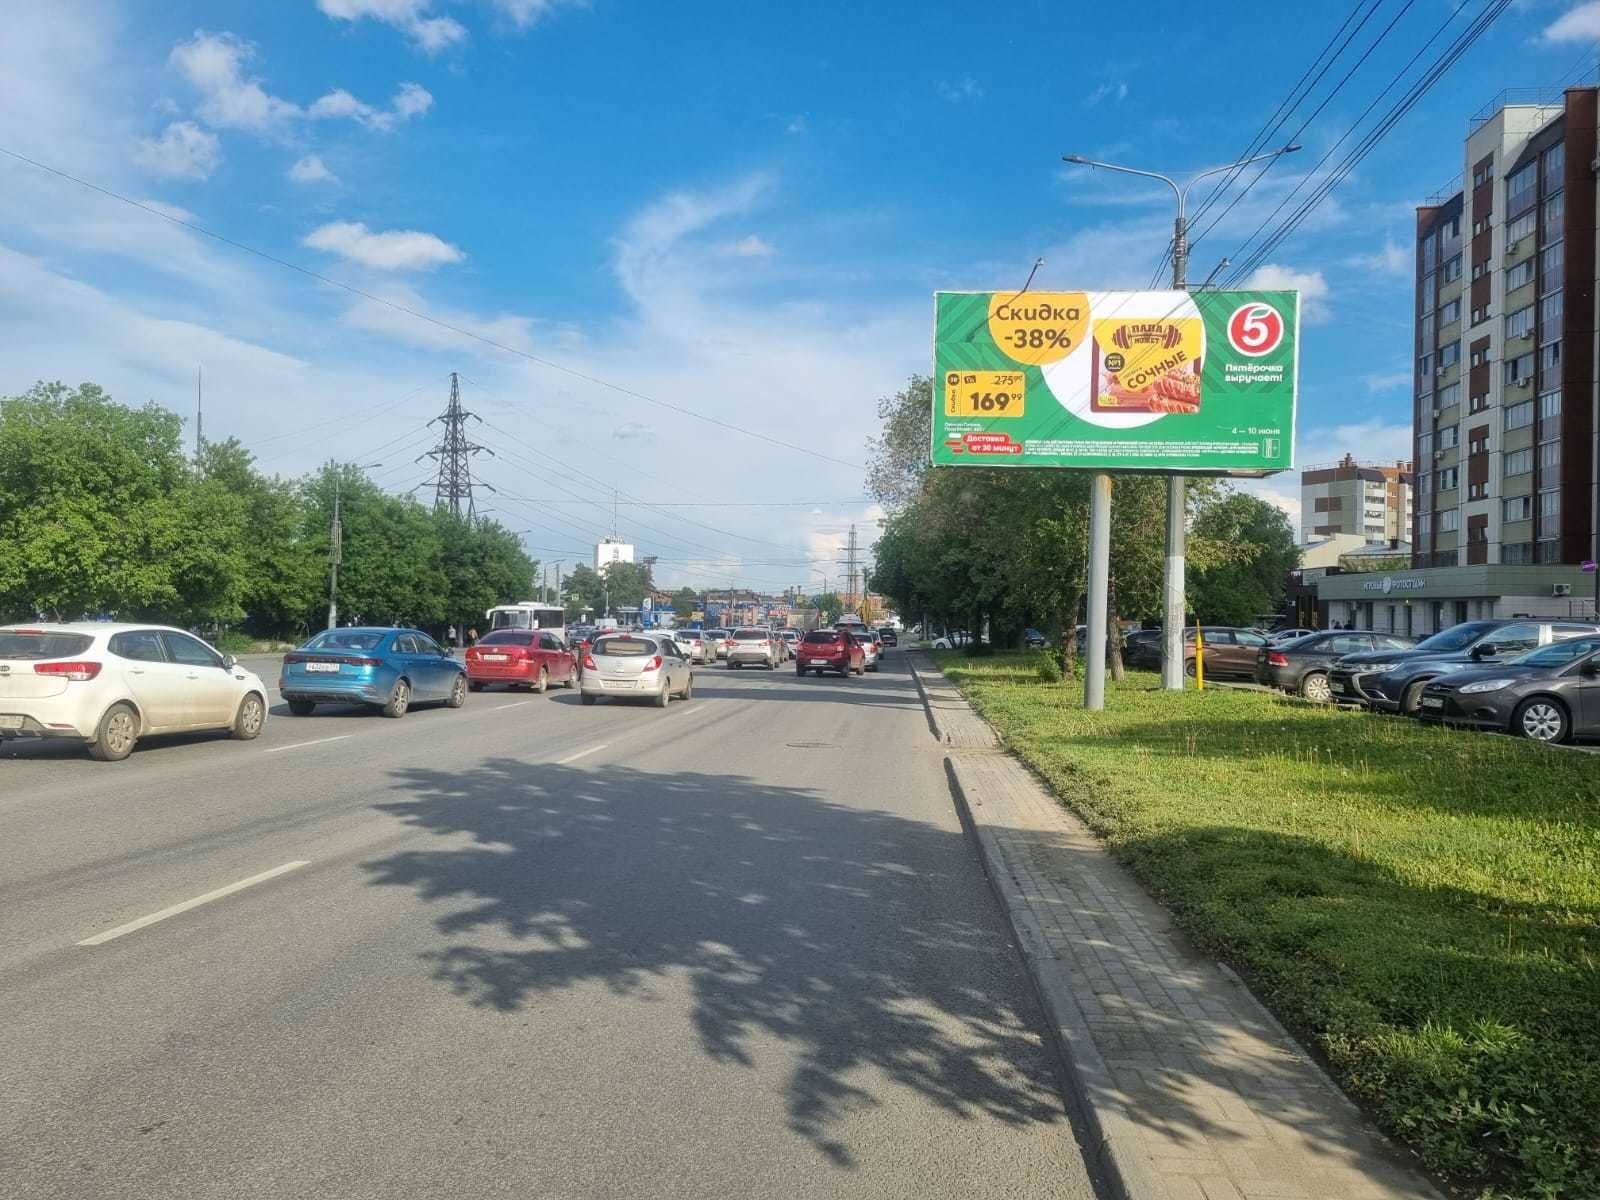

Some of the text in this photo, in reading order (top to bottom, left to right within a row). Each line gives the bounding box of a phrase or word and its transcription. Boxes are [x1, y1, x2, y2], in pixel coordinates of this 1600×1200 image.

[996, 303, 1080, 321] Скидка
[1241, 307, 1272, 347] 5
[1004, 329, 1071, 349] -38%
[1127, 350, 1187, 389] СОЧНЫЕ
[1225, 363, 1283, 373] Пятёрочка
[1225, 373, 1283, 384] выручает!
[970, 392, 1009, 411] 169
